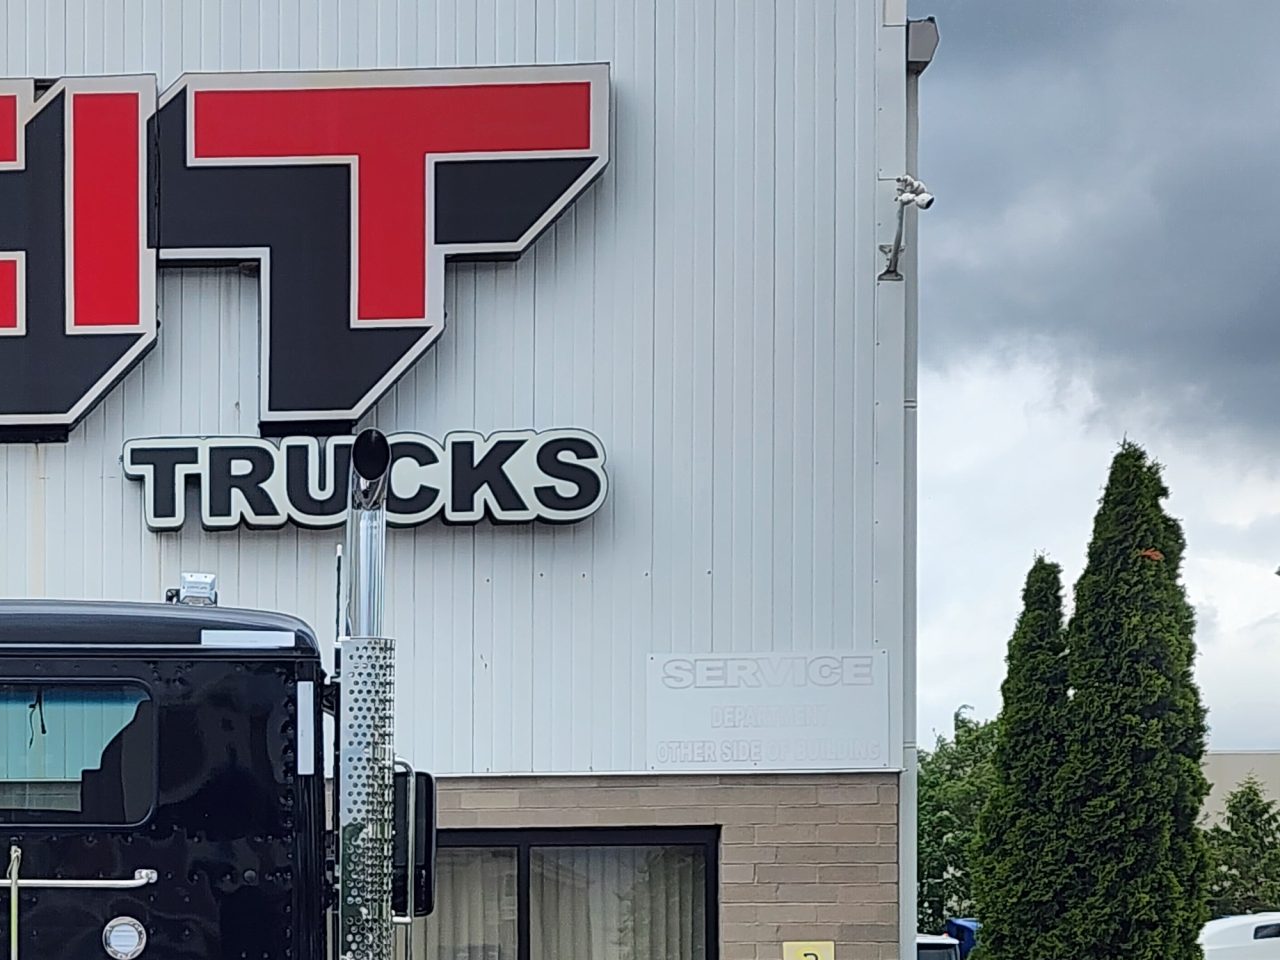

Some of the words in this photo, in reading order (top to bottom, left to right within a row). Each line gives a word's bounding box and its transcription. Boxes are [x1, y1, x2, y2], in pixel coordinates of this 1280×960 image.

[129, 436, 601, 519] TRUCKS
[661, 655, 874, 689] SERVICE
[656, 740, 717, 763] OTHER
[720, 739, 762, 762] SIDE
